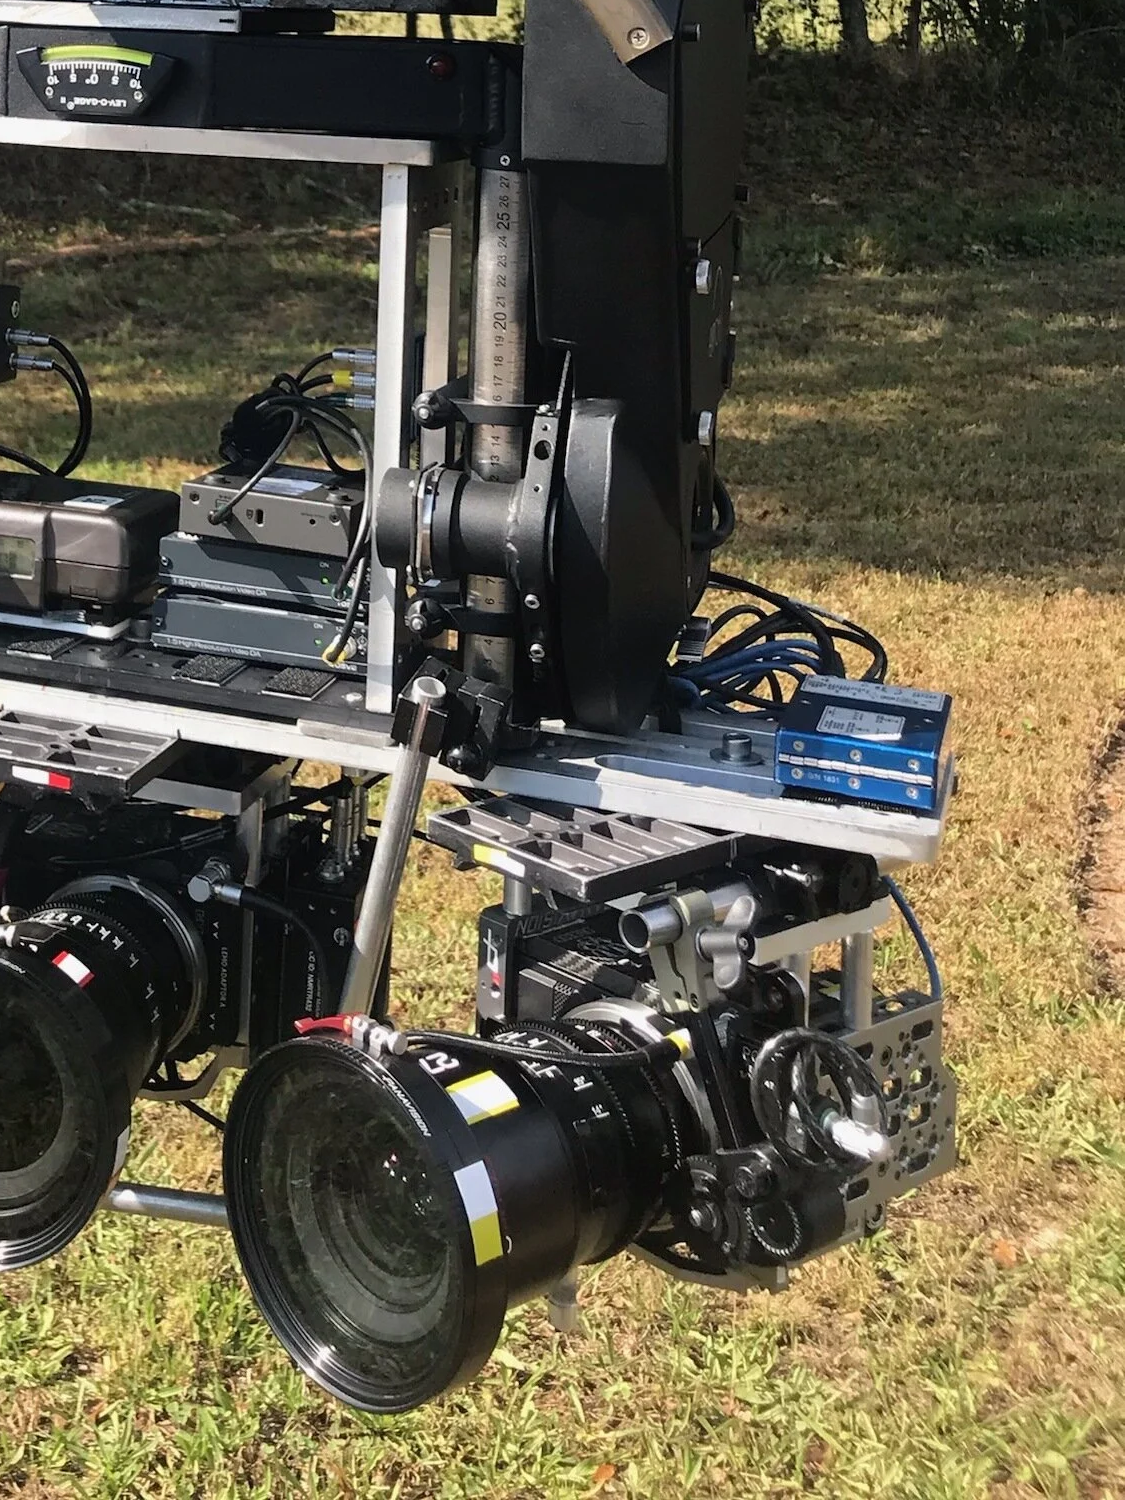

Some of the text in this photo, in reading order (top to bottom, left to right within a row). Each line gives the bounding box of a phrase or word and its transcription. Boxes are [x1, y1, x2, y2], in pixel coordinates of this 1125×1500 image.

[497, 212, 510, 230] 25
[496, 275, 506, 287] 22
[493, 312, 507, 331] 20
[495, 335, 504, 347] 19
[494, 355, 504, 367] 18
[493, 375, 503, 386] 17
[382, 1075, 432, 1137] PANAVISION
